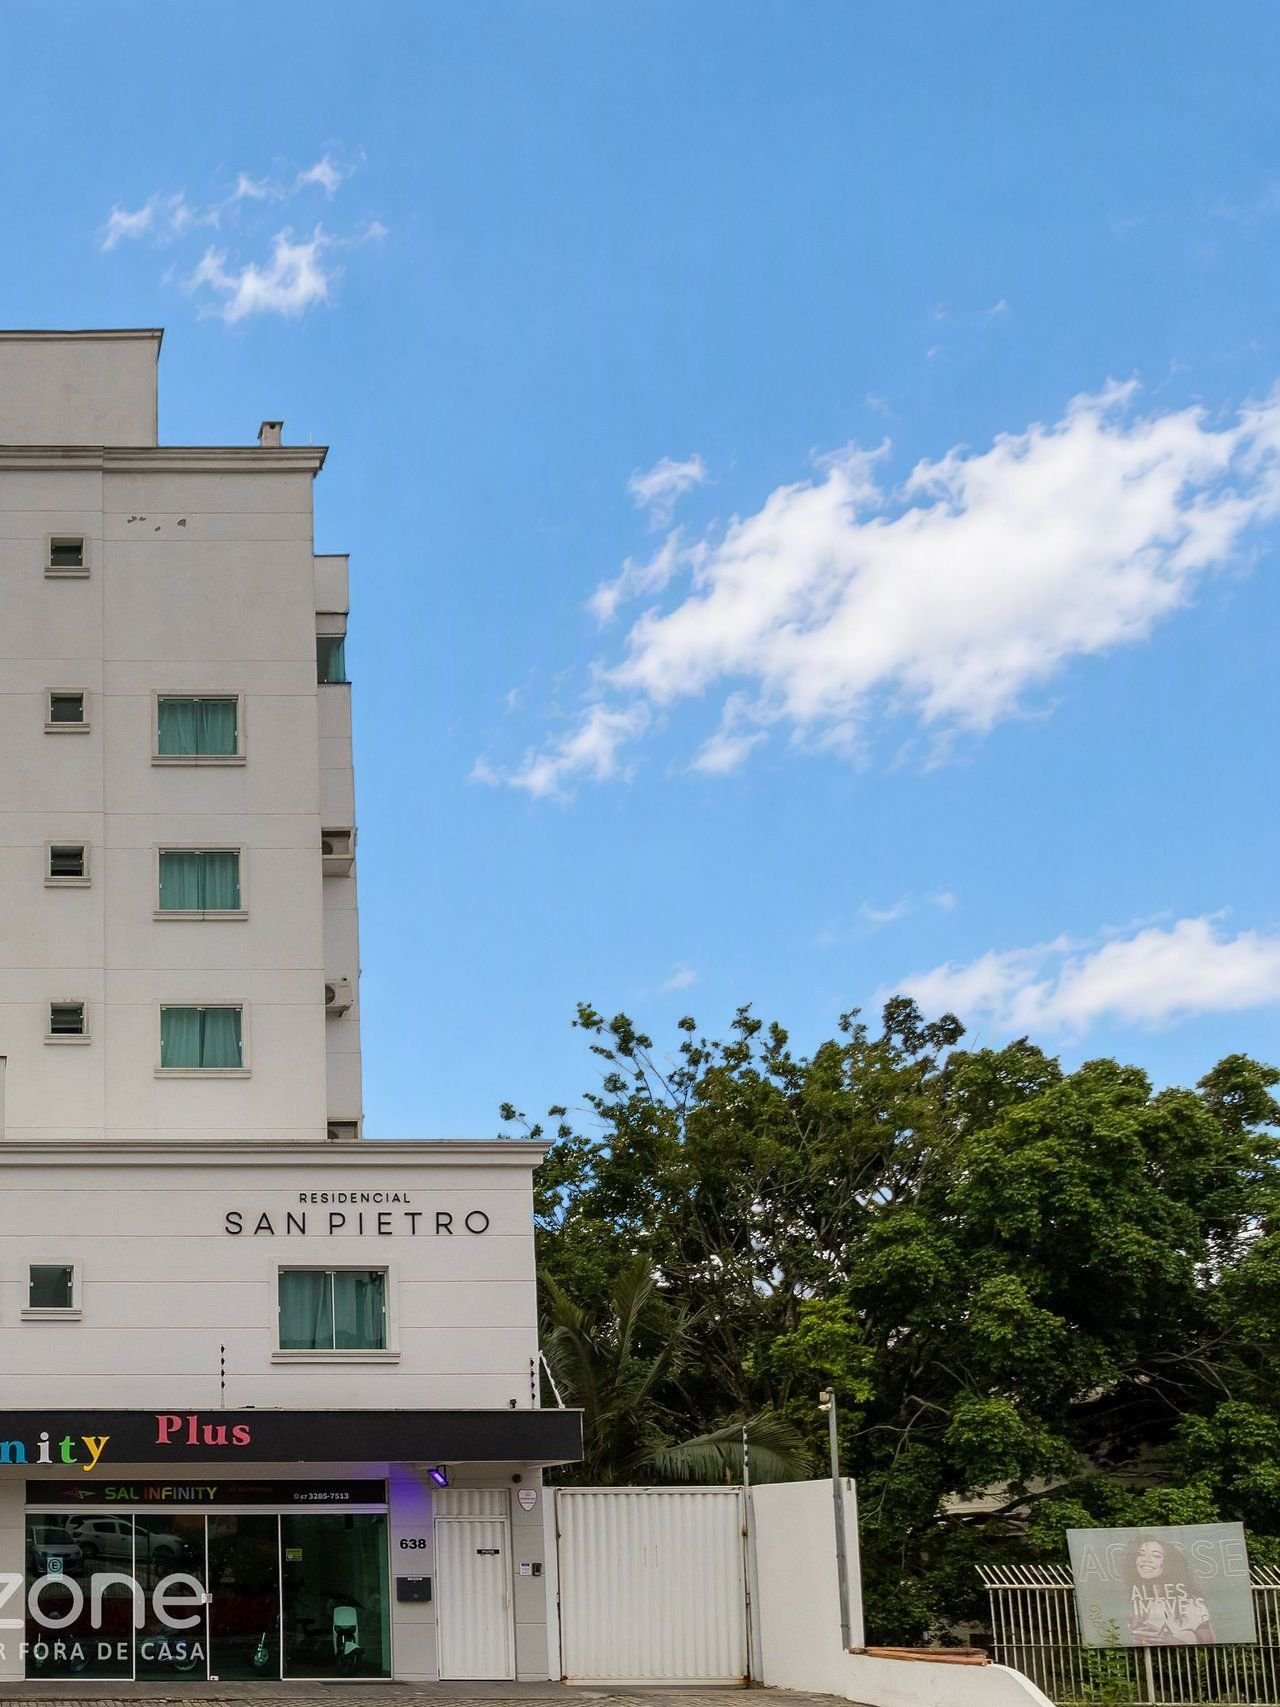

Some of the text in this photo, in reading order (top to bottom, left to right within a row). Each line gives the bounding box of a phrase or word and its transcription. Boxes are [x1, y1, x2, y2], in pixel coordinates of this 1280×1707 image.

[299, 1193, 411, 1203] RESIDENCIAL
[225, 1210, 490, 1235] SAN PIETRO
[155, 1415, 251, 1446] Plus
[105, 1487, 139, 1500] SAL
[144, 1487, 218, 1500] INFINITY
[308, 1492, 349, 1500] 3285-7513
[400, 1539, 427, 1549] 638
[1079, 1538, 1248, 1583] ACSE
[1131, 1583, 1188, 1600] ALLES
